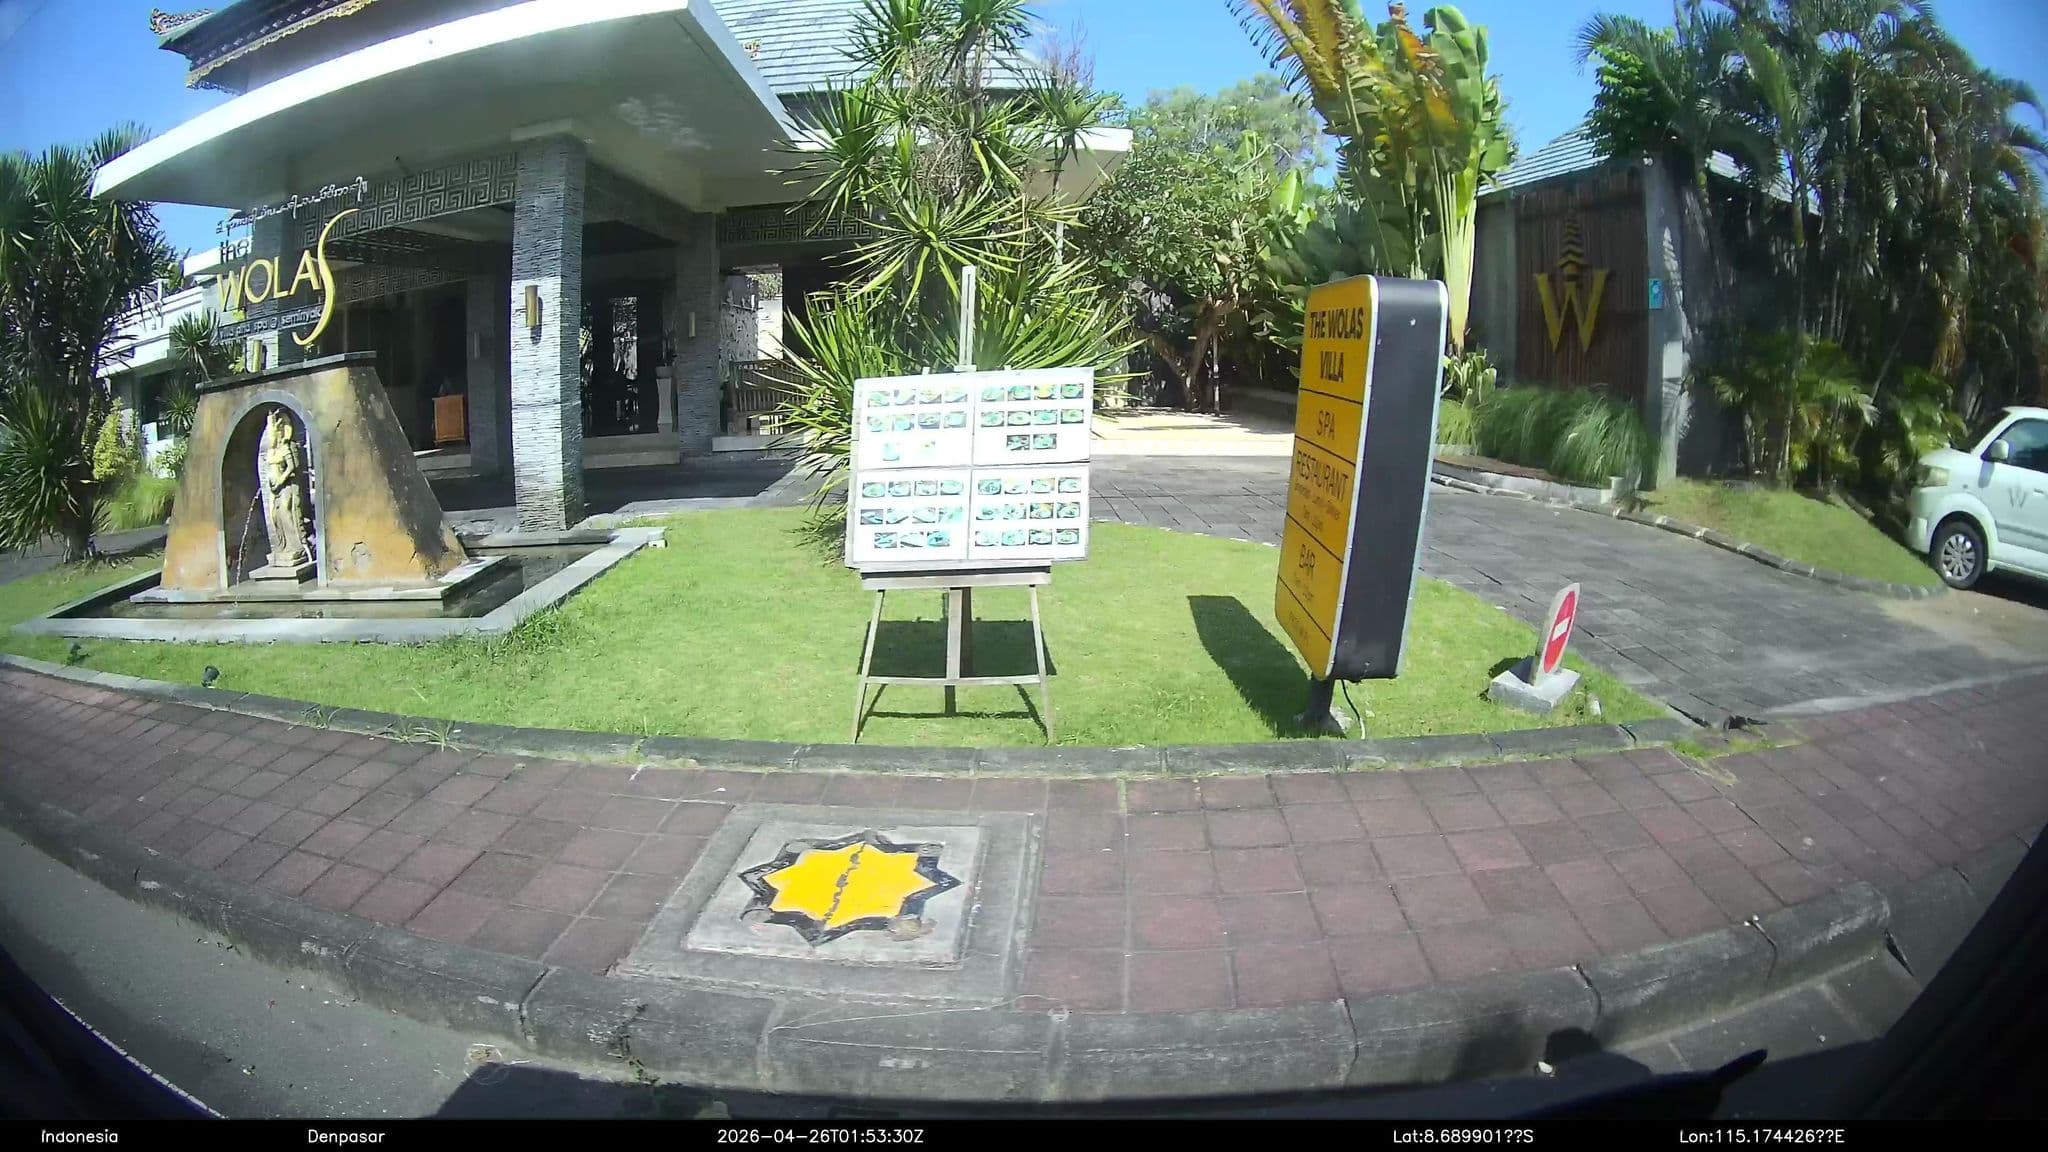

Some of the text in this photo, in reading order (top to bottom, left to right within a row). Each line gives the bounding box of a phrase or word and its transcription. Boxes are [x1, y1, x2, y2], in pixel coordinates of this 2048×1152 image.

[219, 239, 251, 264] the
[216, 208, 360, 346] WOLAS
[1310, 307, 1364, 341] THE WOLAS
[1533, 268, 1609, 353] W
[1319, 350, 1345, 383] VILLA
[1316, 409, 1336, 441] SPA
[1296, 449, 1349, 502] RESTAURANT
[1298, 543, 1316, 577] BAR
